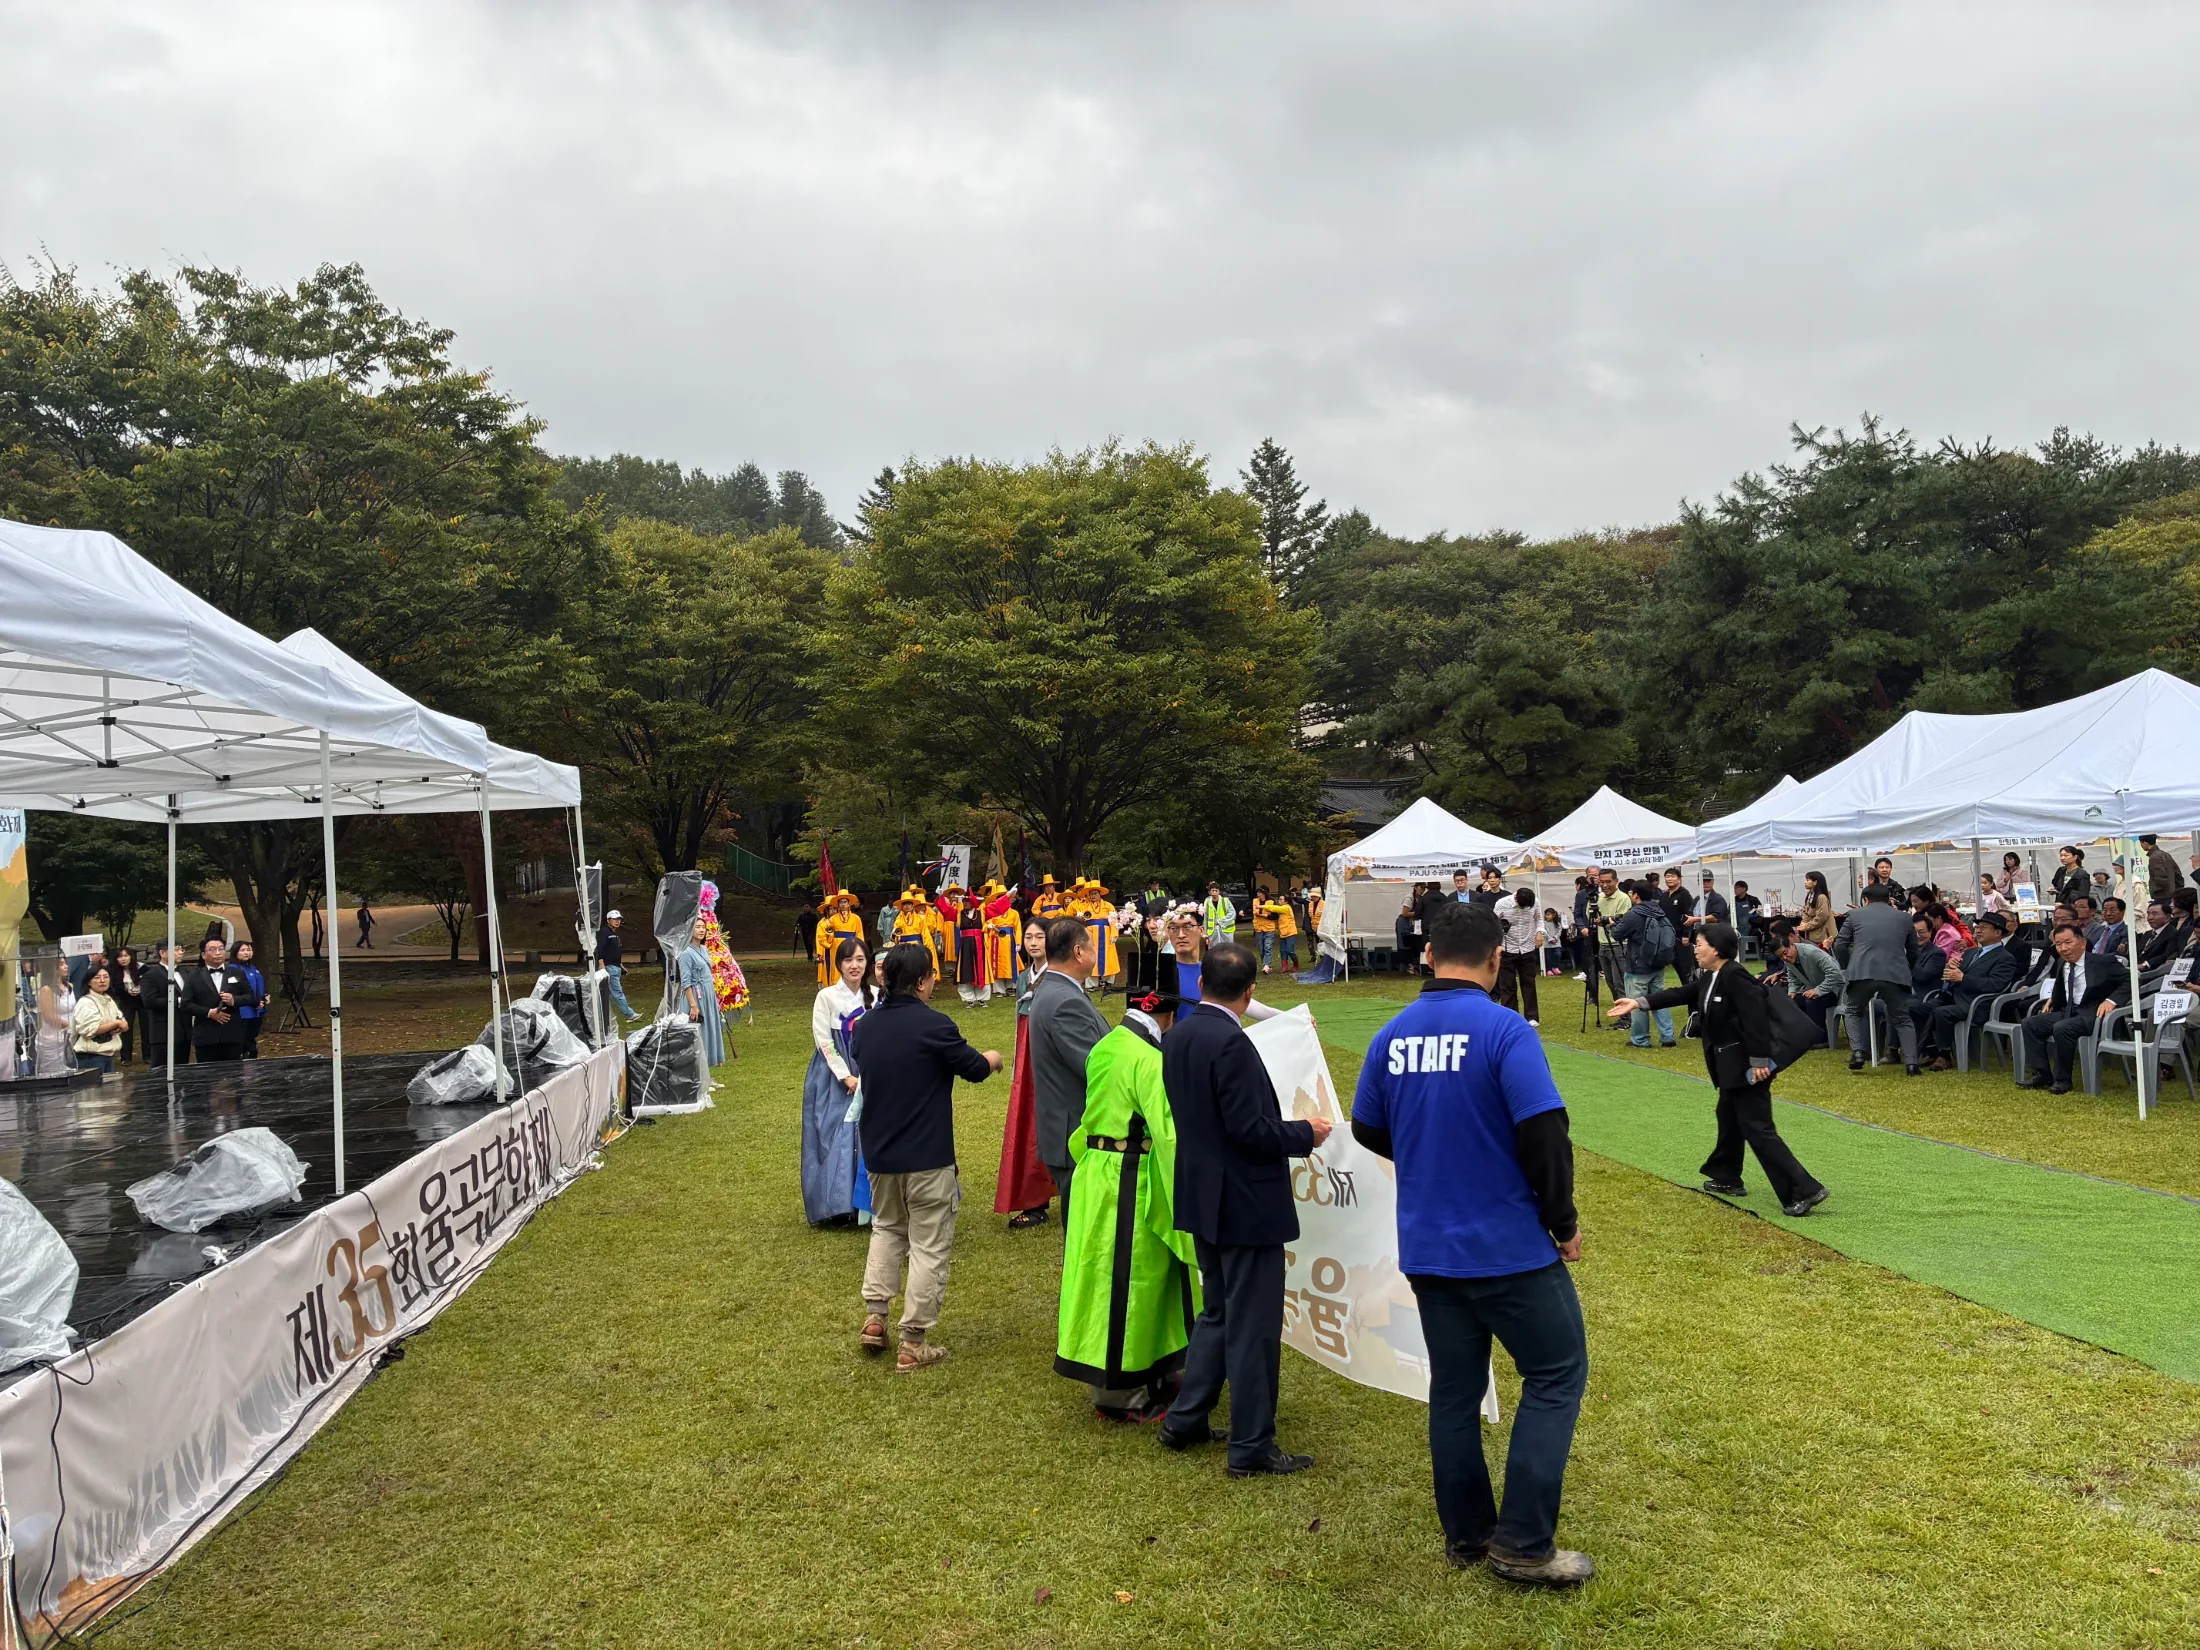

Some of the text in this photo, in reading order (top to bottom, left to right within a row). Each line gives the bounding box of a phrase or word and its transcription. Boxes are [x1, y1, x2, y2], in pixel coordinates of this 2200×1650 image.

[2020, 836, 2054, 845] 옹기박물관
[1593, 845, 1670, 859] 한지 고무신 만들기
[2161, 998, 2183, 1009] 김경일
[1388, 1034, 1469, 1075] STAFF
[419, 1106, 551, 1288] 율곡문화제
